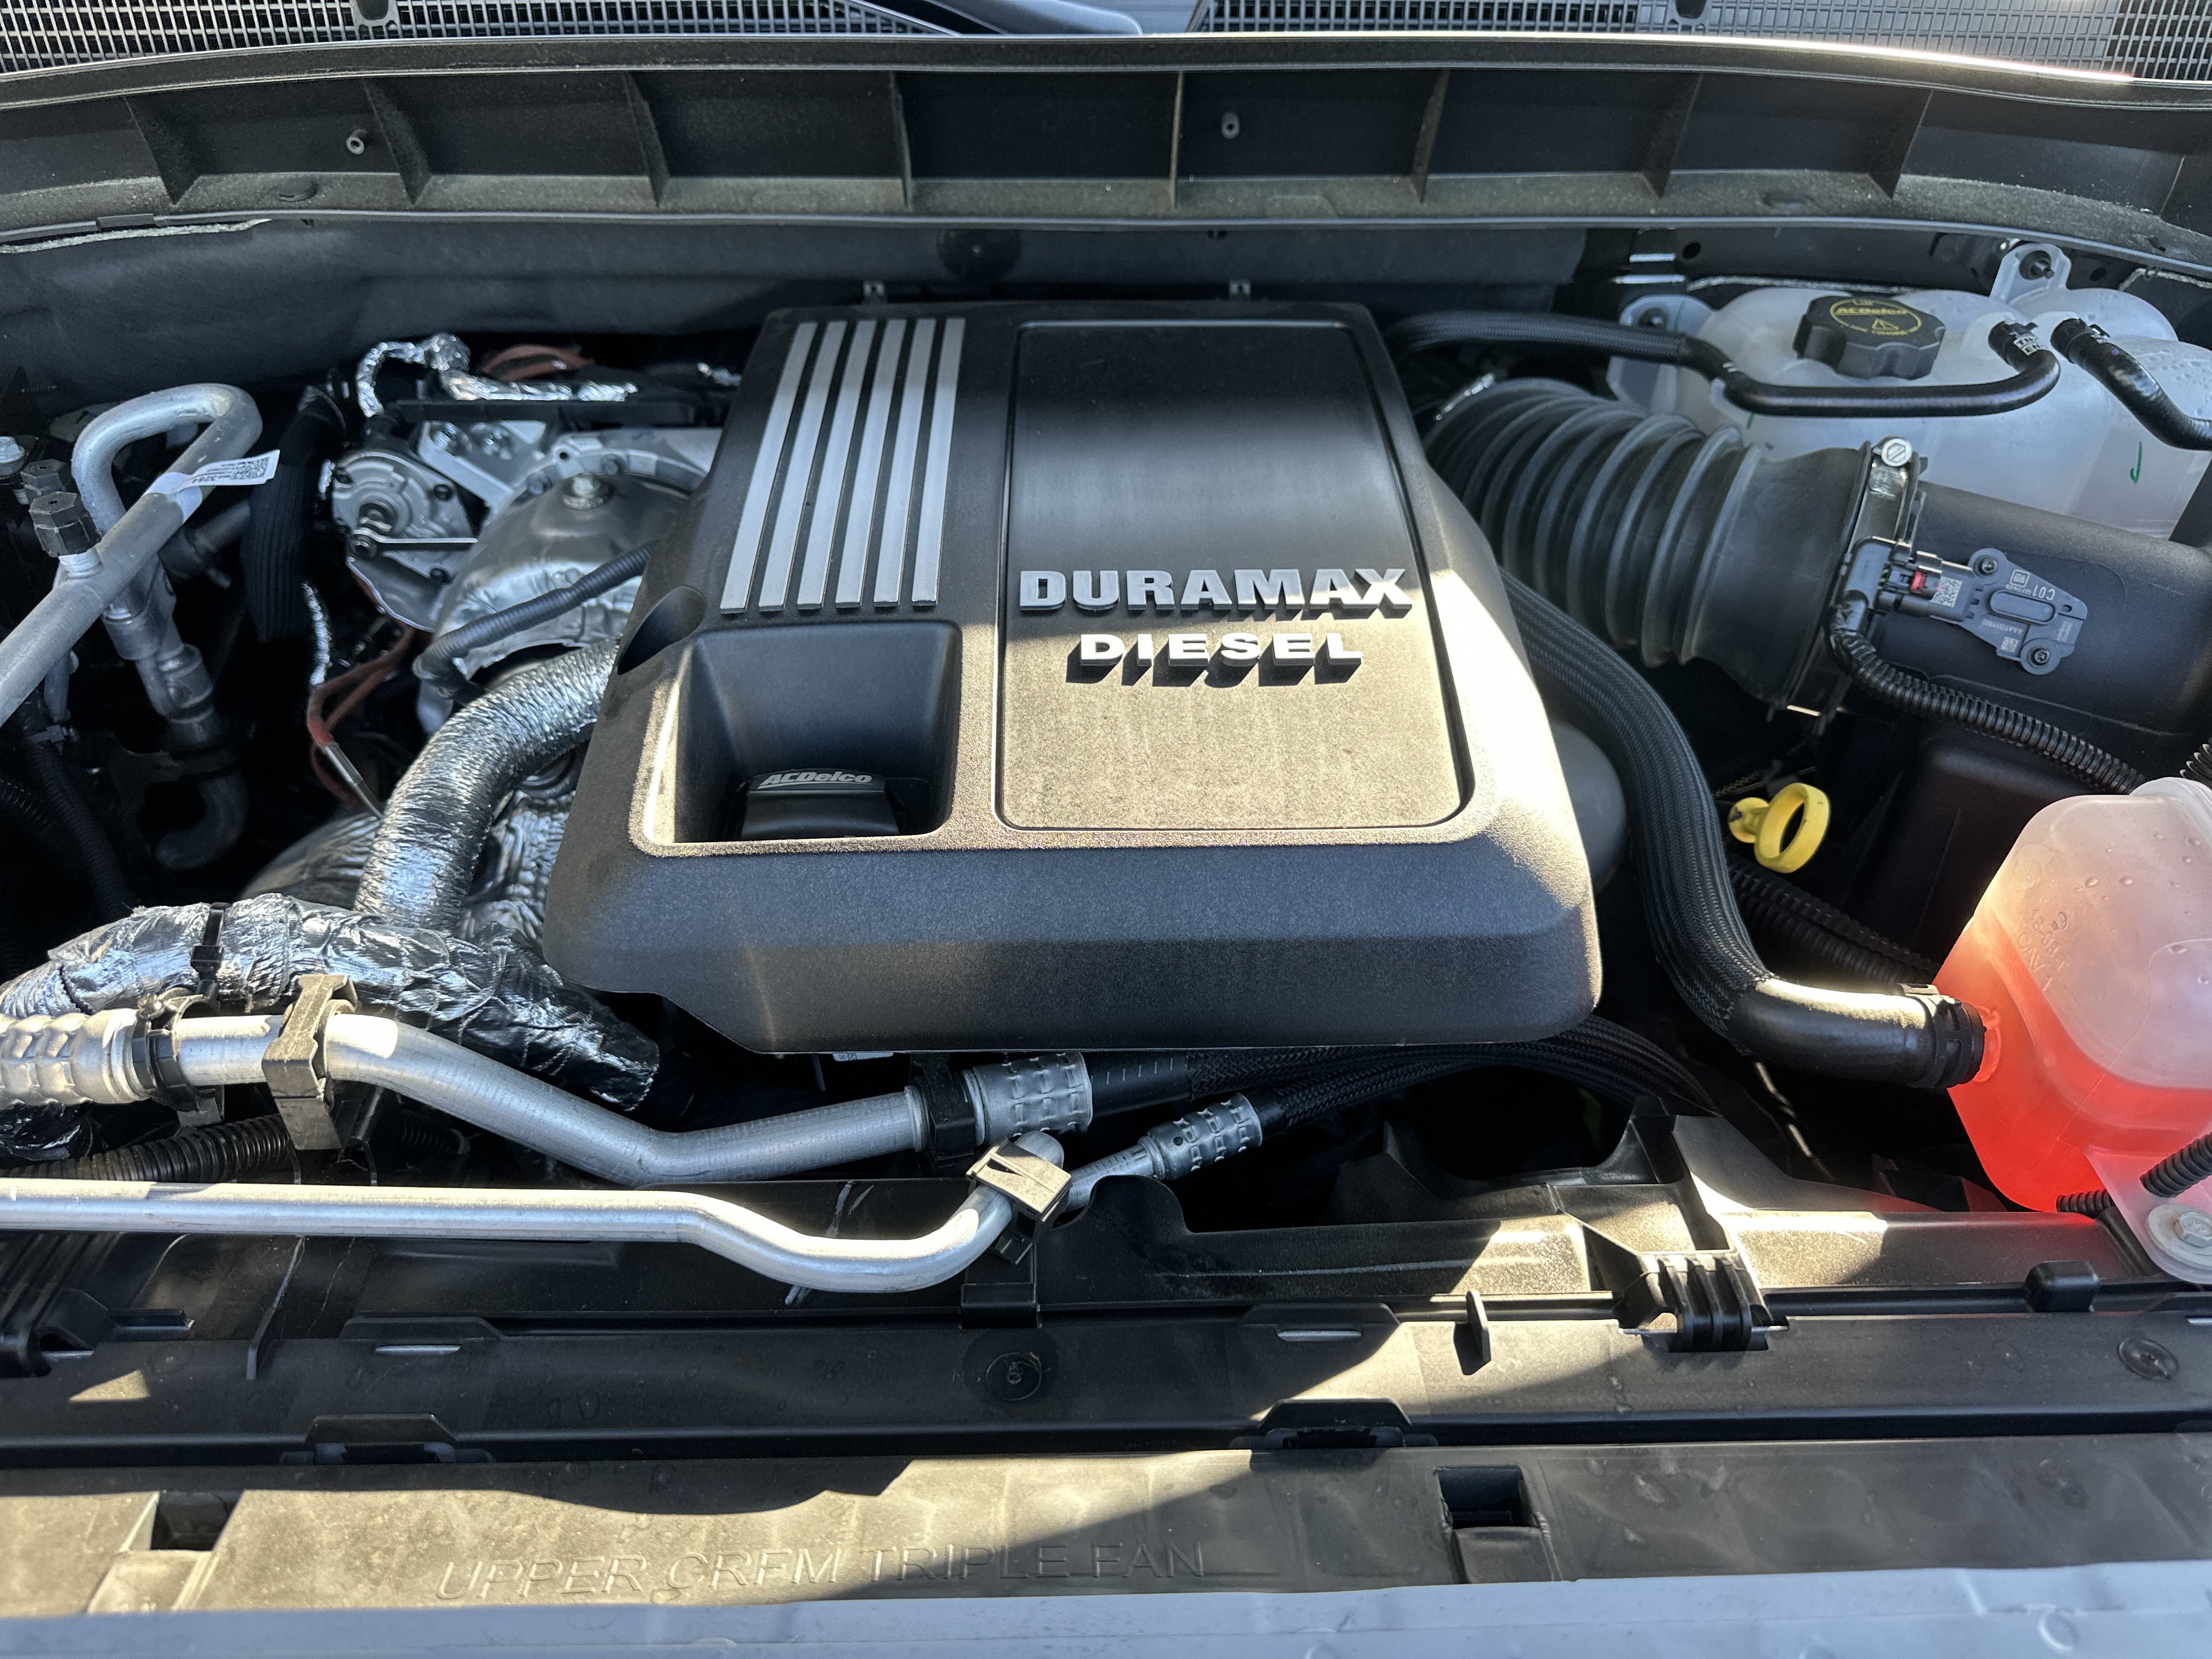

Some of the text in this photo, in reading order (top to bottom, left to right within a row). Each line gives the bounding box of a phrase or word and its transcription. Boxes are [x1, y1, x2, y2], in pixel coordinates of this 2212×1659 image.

[1019, 568, 1413, 611] DURAMAX
[2032, 584, 2056, 601] C01
[1080, 632, 1363, 668] DIESEL
[758, 771, 873, 789] ACDelco
[435, 1541, 1205, 1600] UPPER CRFM TRIPLE FAN
